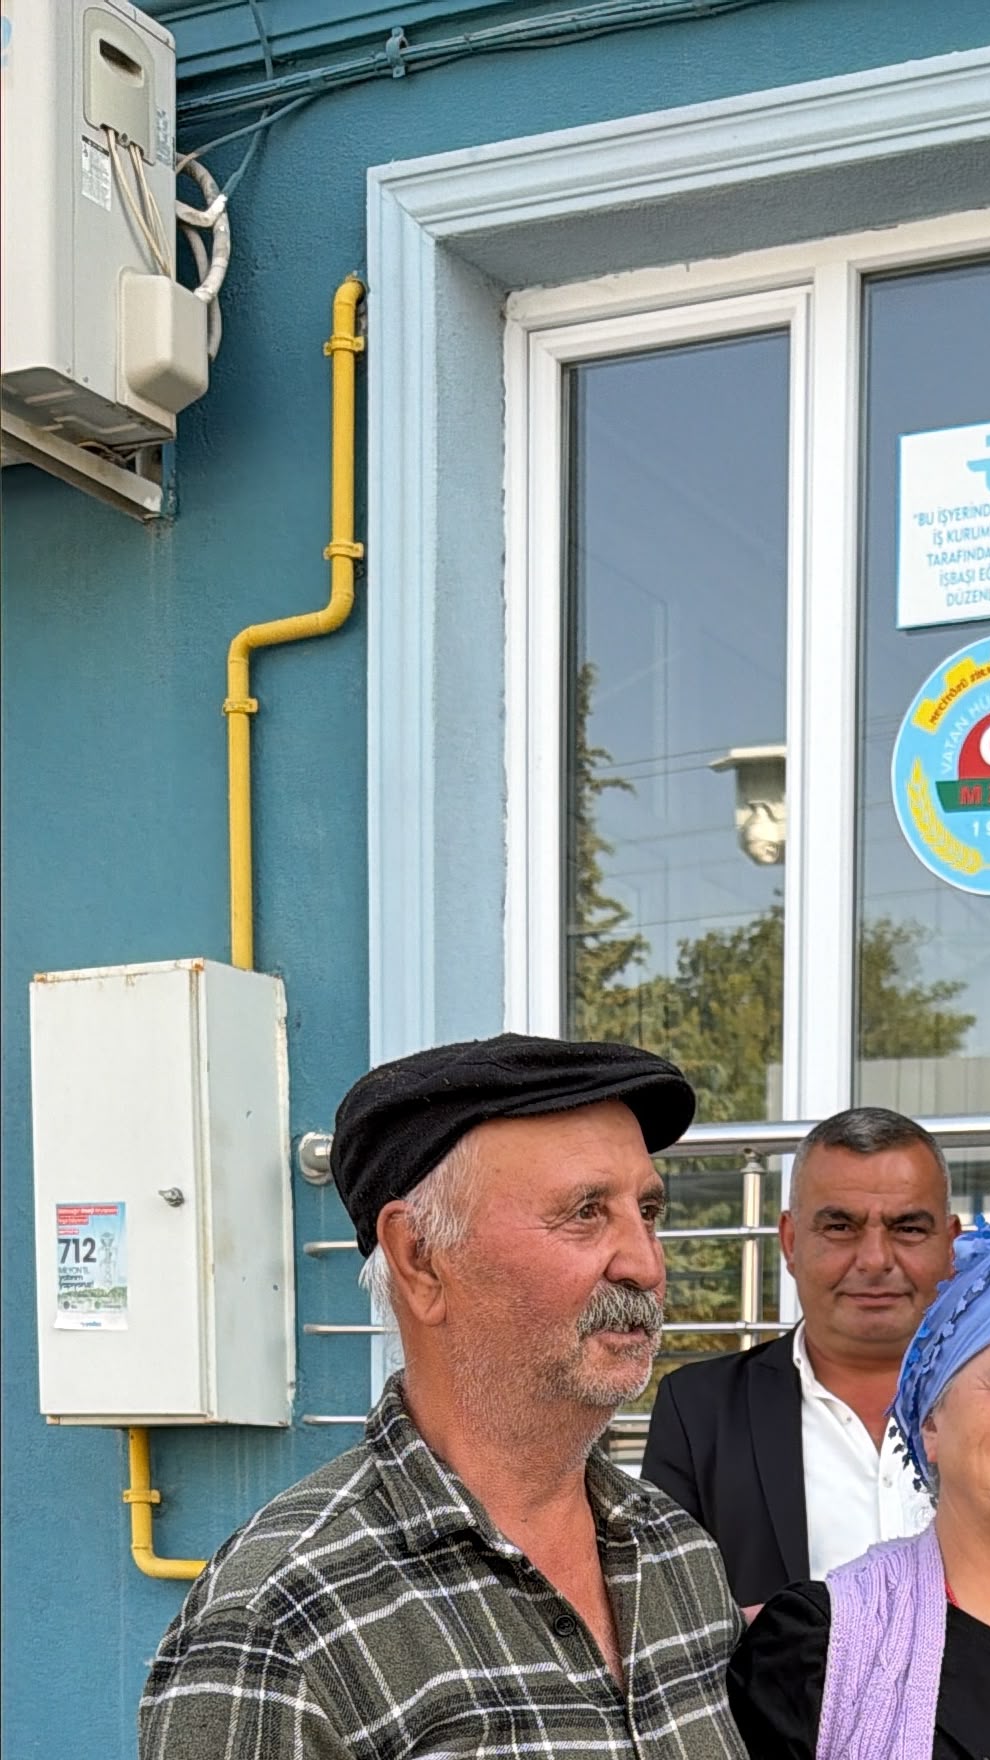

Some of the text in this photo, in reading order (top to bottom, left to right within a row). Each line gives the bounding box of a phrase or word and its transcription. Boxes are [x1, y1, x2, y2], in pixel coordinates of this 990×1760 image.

[932, 529, 944, 546] İŞ
[940, 717, 969, 776] VATAN
[58, 1238, 97, 1264] 712
